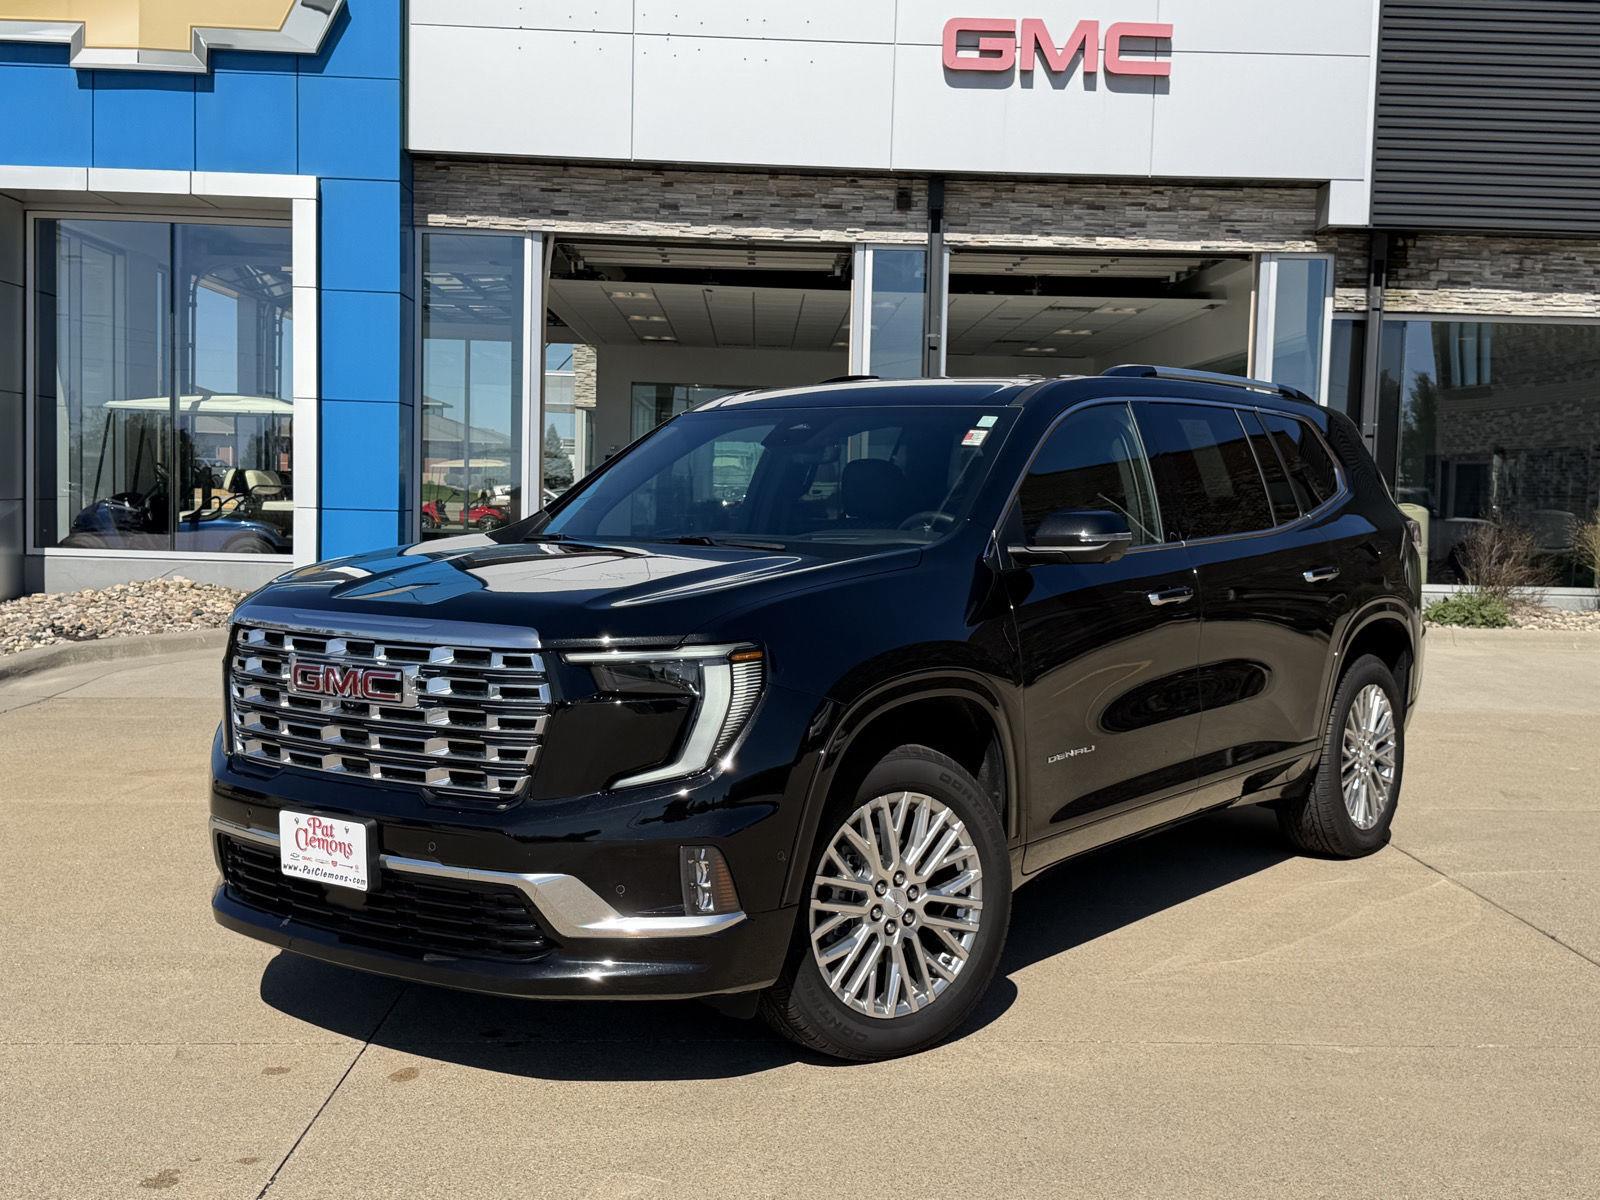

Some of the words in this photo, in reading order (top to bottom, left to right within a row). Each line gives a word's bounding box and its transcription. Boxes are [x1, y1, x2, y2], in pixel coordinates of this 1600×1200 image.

[943, 17, 1174, 76] GMC
[293, 662, 402, 702] GMC
[1047, 745, 1096, 764] DENALI
[307, 816, 336, 839] Pat
[295, 827, 354, 860] Clemons
[283, 863, 367, 886] www.PatClemons.com
